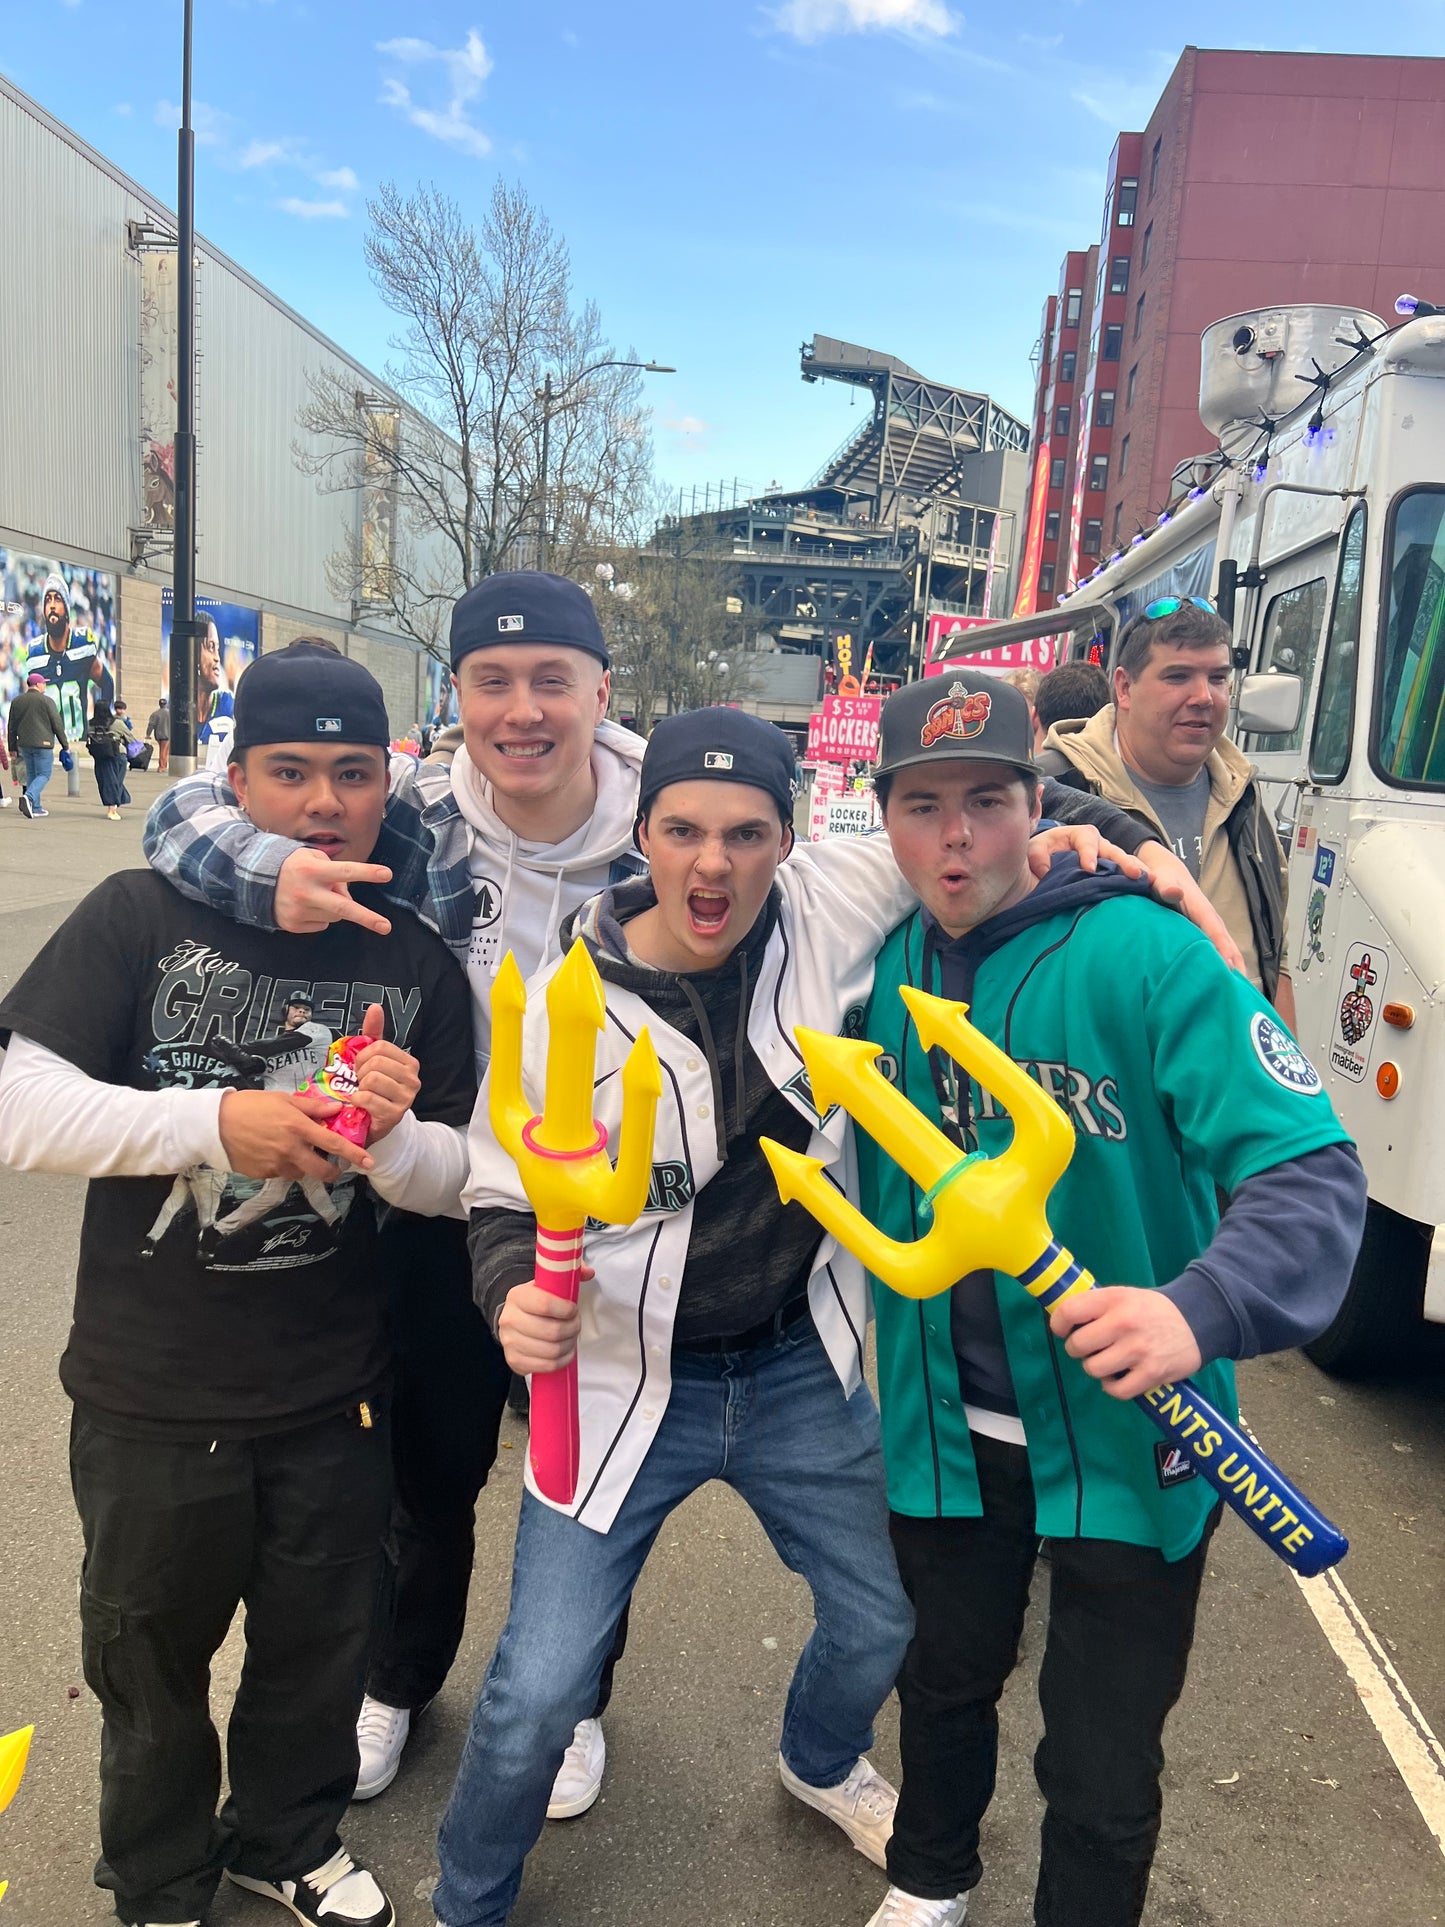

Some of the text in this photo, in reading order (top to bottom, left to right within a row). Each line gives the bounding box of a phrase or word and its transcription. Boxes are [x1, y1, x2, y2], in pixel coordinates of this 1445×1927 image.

[836, 634, 852, 675] HOT
[832, 698, 854, 716] $5
[821, 716, 878, 748] LOCKERS
[825, 746, 872, 757] INSURED
[830, 808, 867, 821] LOCKER
[829, 822, 866, 834] RENTALS
[158, 940, 239, 976] Ken
[1332, 1052, 1363, 1076] matter
[1217, 1452, 1314, 1554] UNITE
